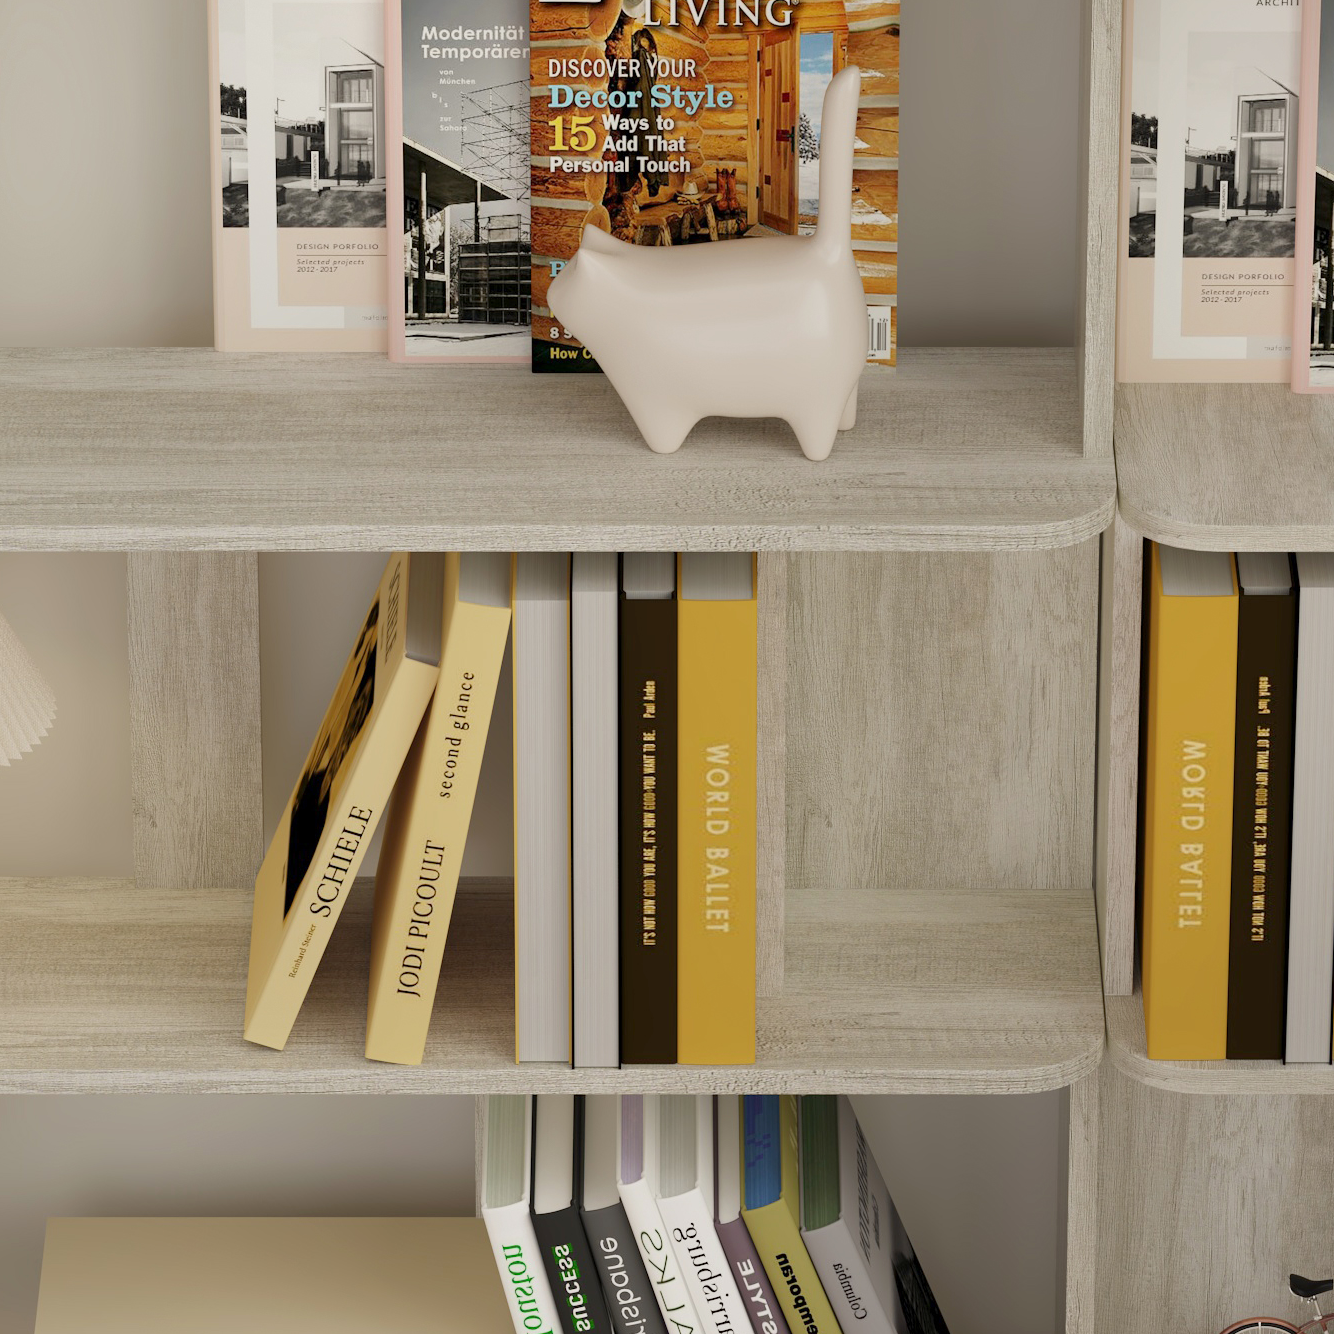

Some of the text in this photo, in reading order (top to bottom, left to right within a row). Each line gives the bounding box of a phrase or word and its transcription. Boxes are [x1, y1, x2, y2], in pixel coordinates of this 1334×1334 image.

[421, 25, 525, 41] Modernität
[421, 44, 529, 61] Temporären
[549, 58, 696, 78] DISCOVER YOUR
[548, 84, 733, 115] Decor Style
[548, 115, 675, 152] 15 Ways to
[602, 136, 686, 152] Add That
[550, 157, 691, 173] Personal Touch
[439, 671, 475, 798] second glance
[706, 743, 730, 932] WORLD BALLET
[309, 805, 373, 917] SCHIELE
[397, 839, 445, 997] JODI PICOULT
[288, 924, 317, 979] Reinhard Steiner
